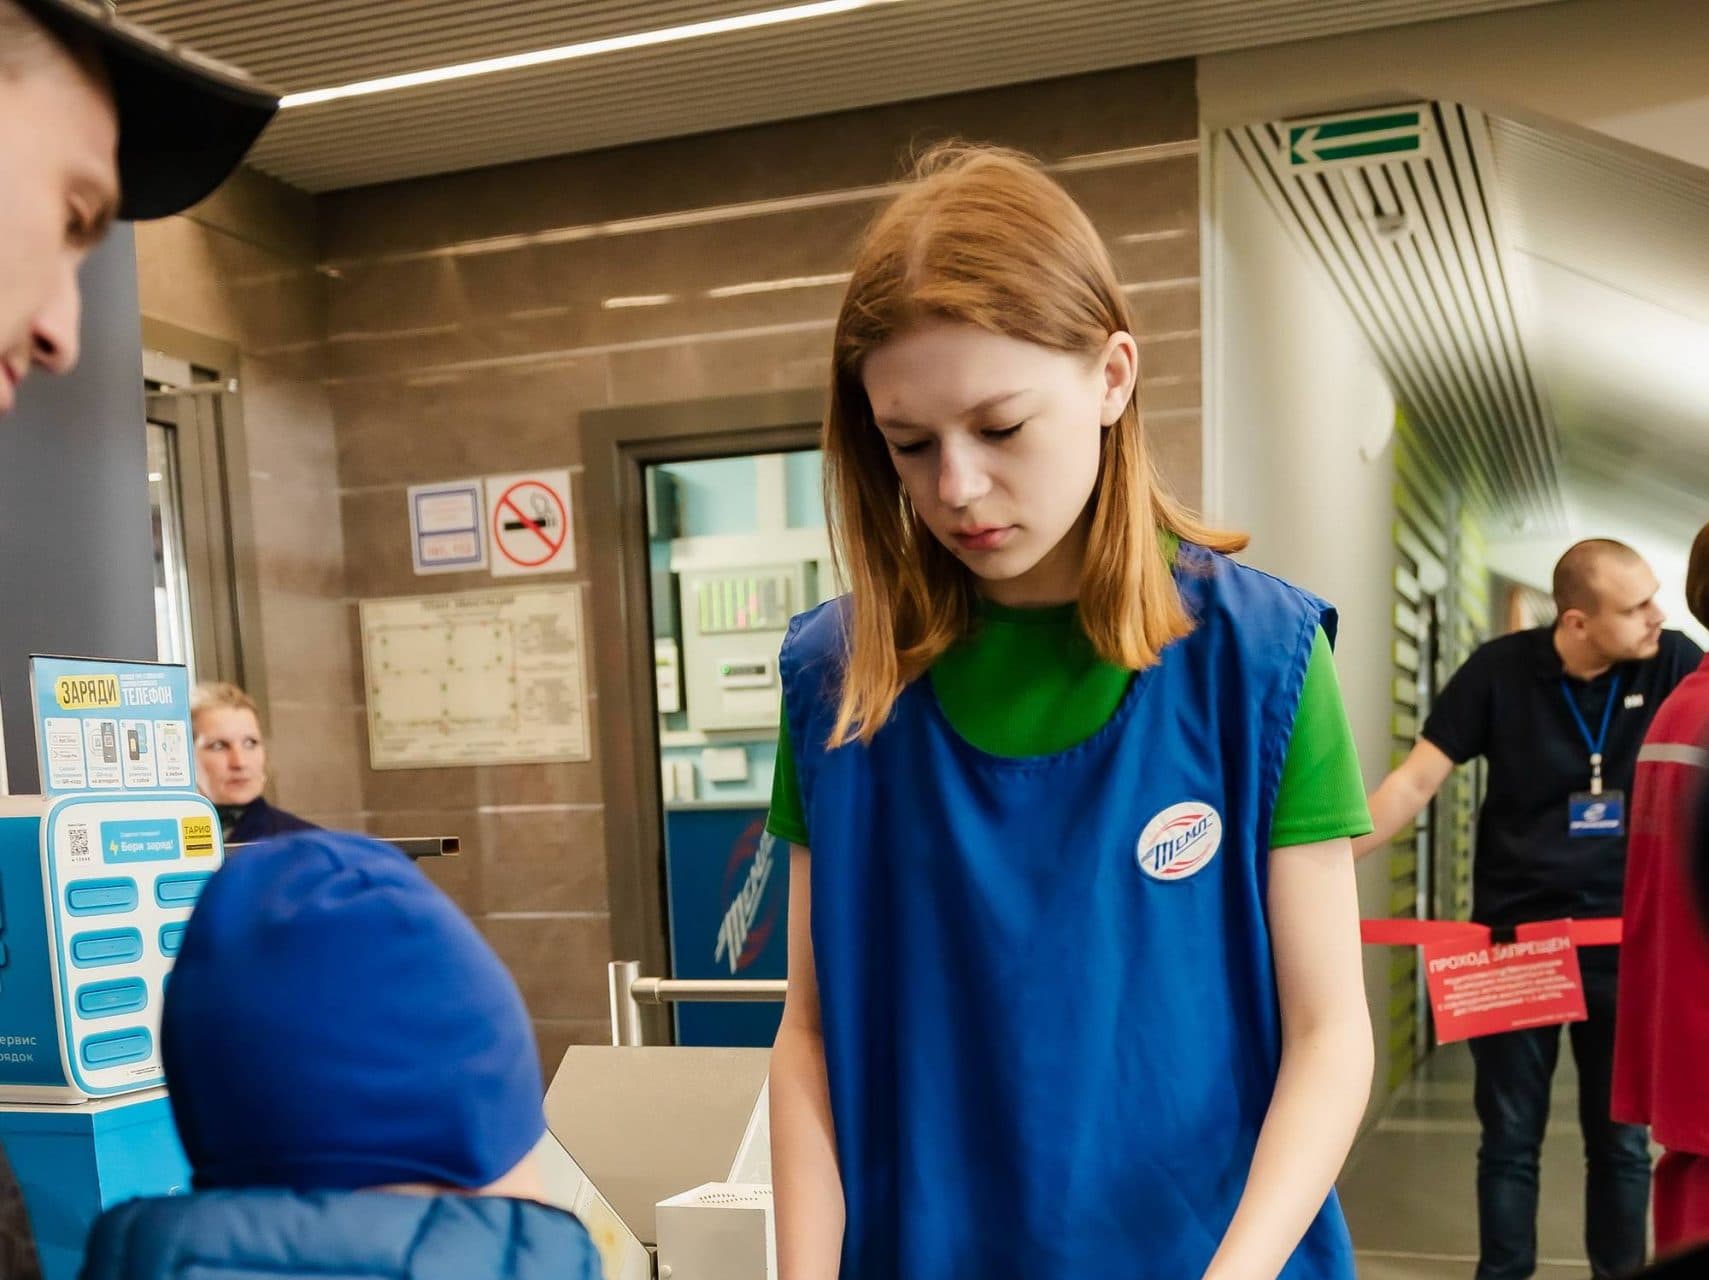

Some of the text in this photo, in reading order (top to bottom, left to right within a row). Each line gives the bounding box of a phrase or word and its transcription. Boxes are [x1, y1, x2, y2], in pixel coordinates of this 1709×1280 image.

[61, 679, 173, 706] ЗАРЯДИ ТЕЛЕФОН
[184, 825, 211, 835] ТАРИФ
[1429, 936, 1571, 974] ПРОХОД ЗАПРЕЩЕН
